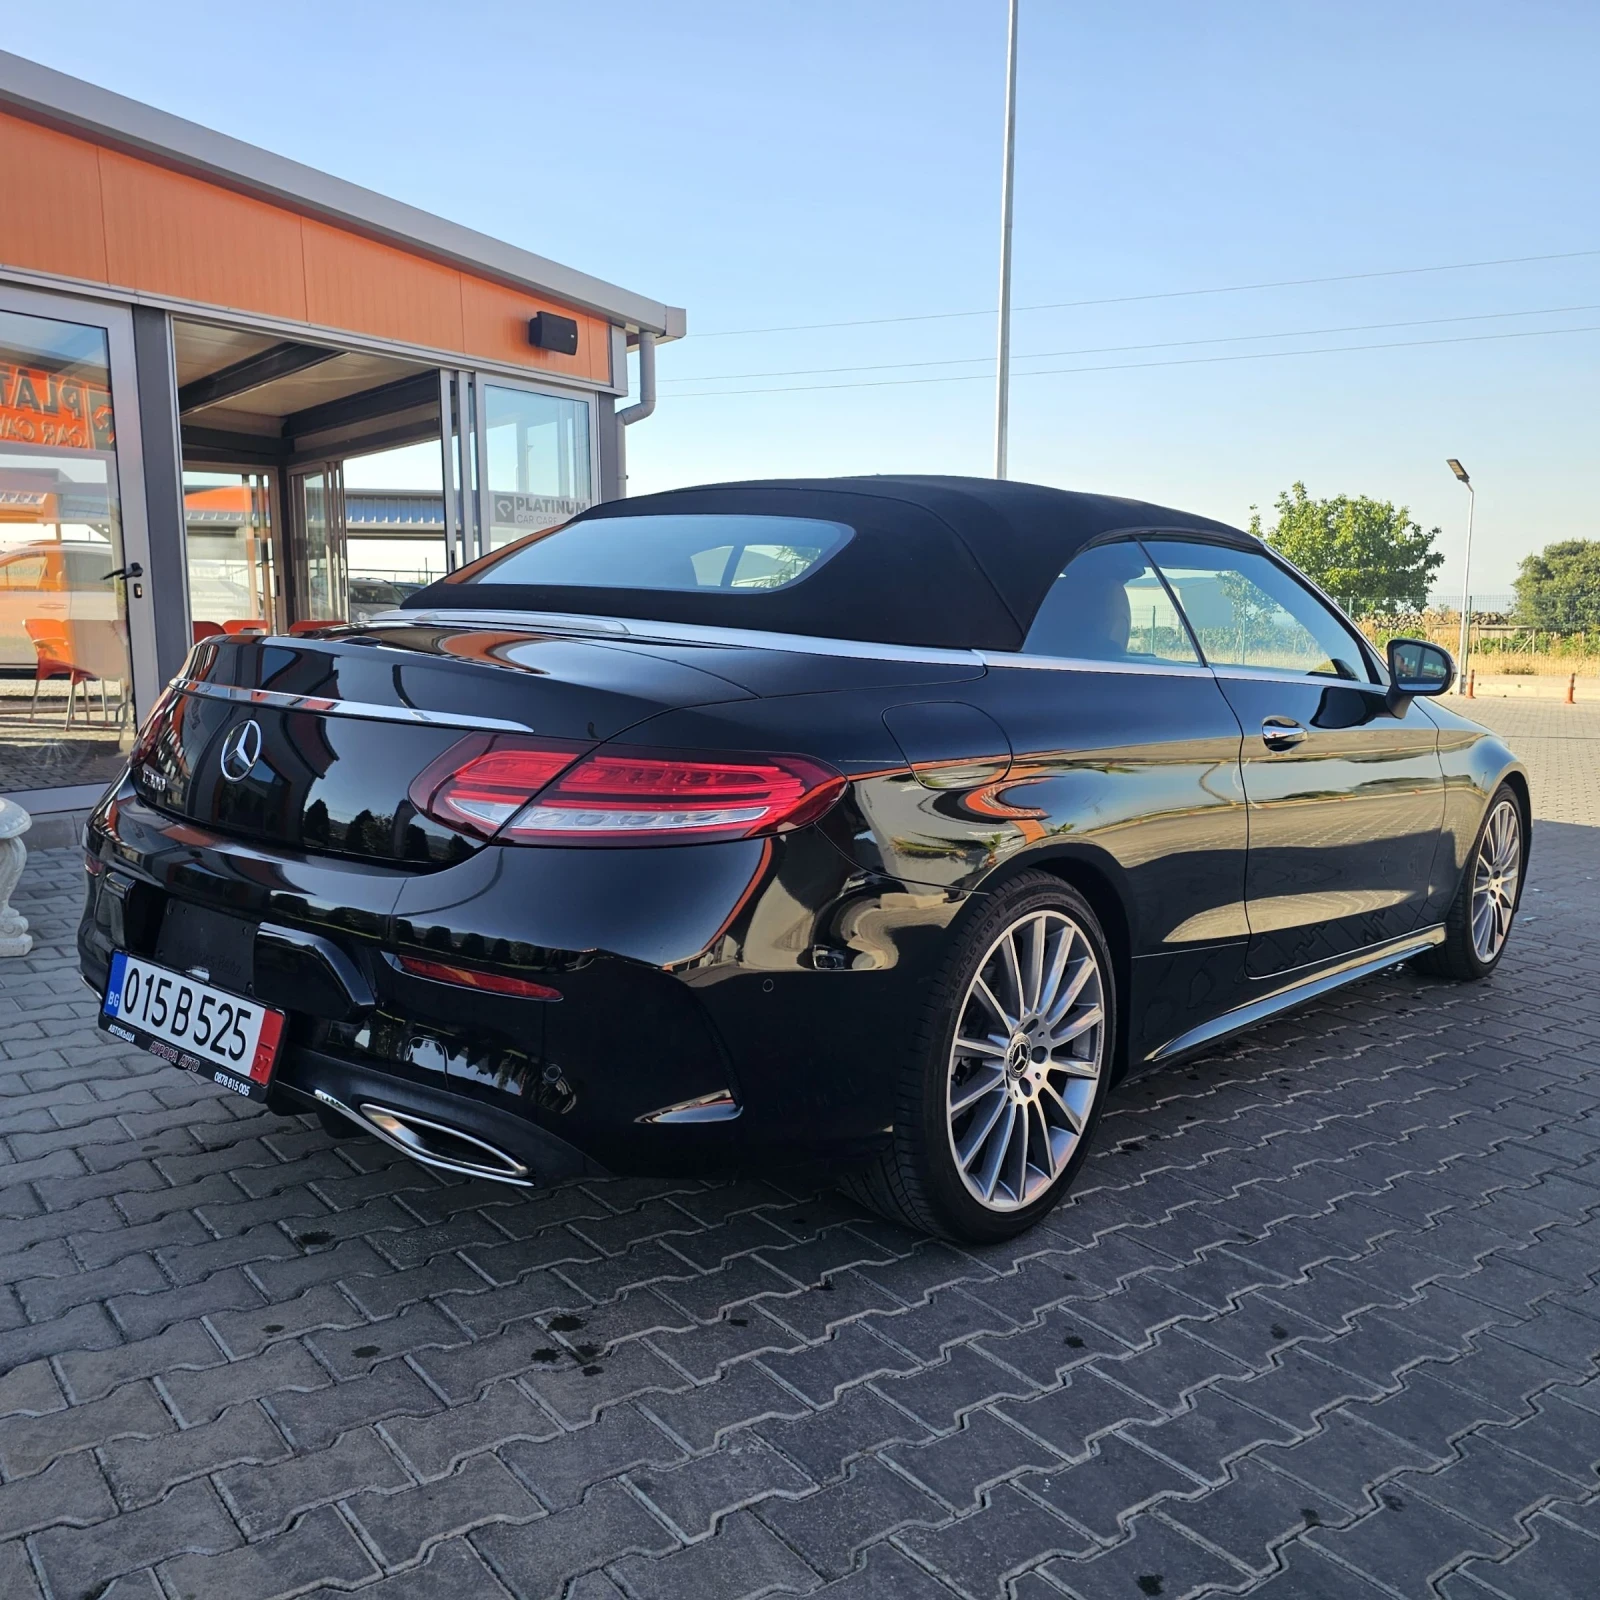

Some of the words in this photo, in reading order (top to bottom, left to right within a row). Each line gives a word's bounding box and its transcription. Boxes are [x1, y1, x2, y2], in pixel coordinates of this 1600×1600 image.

[516, 497, 586, 515] PLATINUM
[516, 514, 534, 524] CAR
[536, 516, 557, 526] CARE
[983, 919, 994, 933] 19
[107, 991, 120, 1007] BG
[214, 1071, 228, 1087] 0878
[227, 1078, 240, 1091] 815
[238, 1083, 251, 1096] 005
